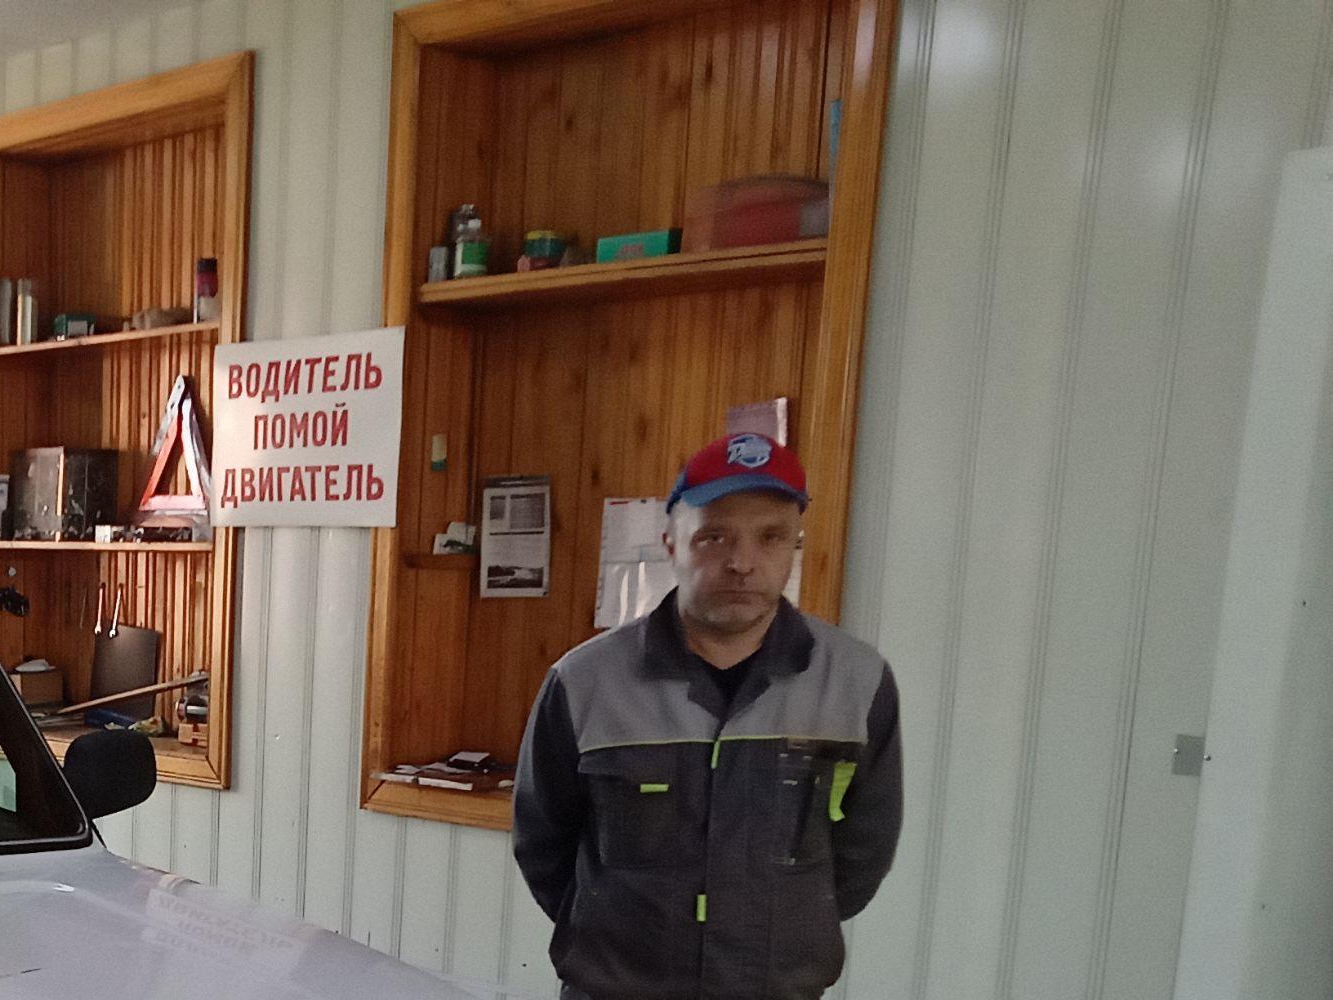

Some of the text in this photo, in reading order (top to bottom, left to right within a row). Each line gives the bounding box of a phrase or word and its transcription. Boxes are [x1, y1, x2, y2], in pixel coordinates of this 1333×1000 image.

[228, 352, 383, 403] ВОДИТЕЛЬ
[253, 402, 349, 450] ПОМОЙ
[220, 463, 385, 508] ДВИГАТЕЛЬ
